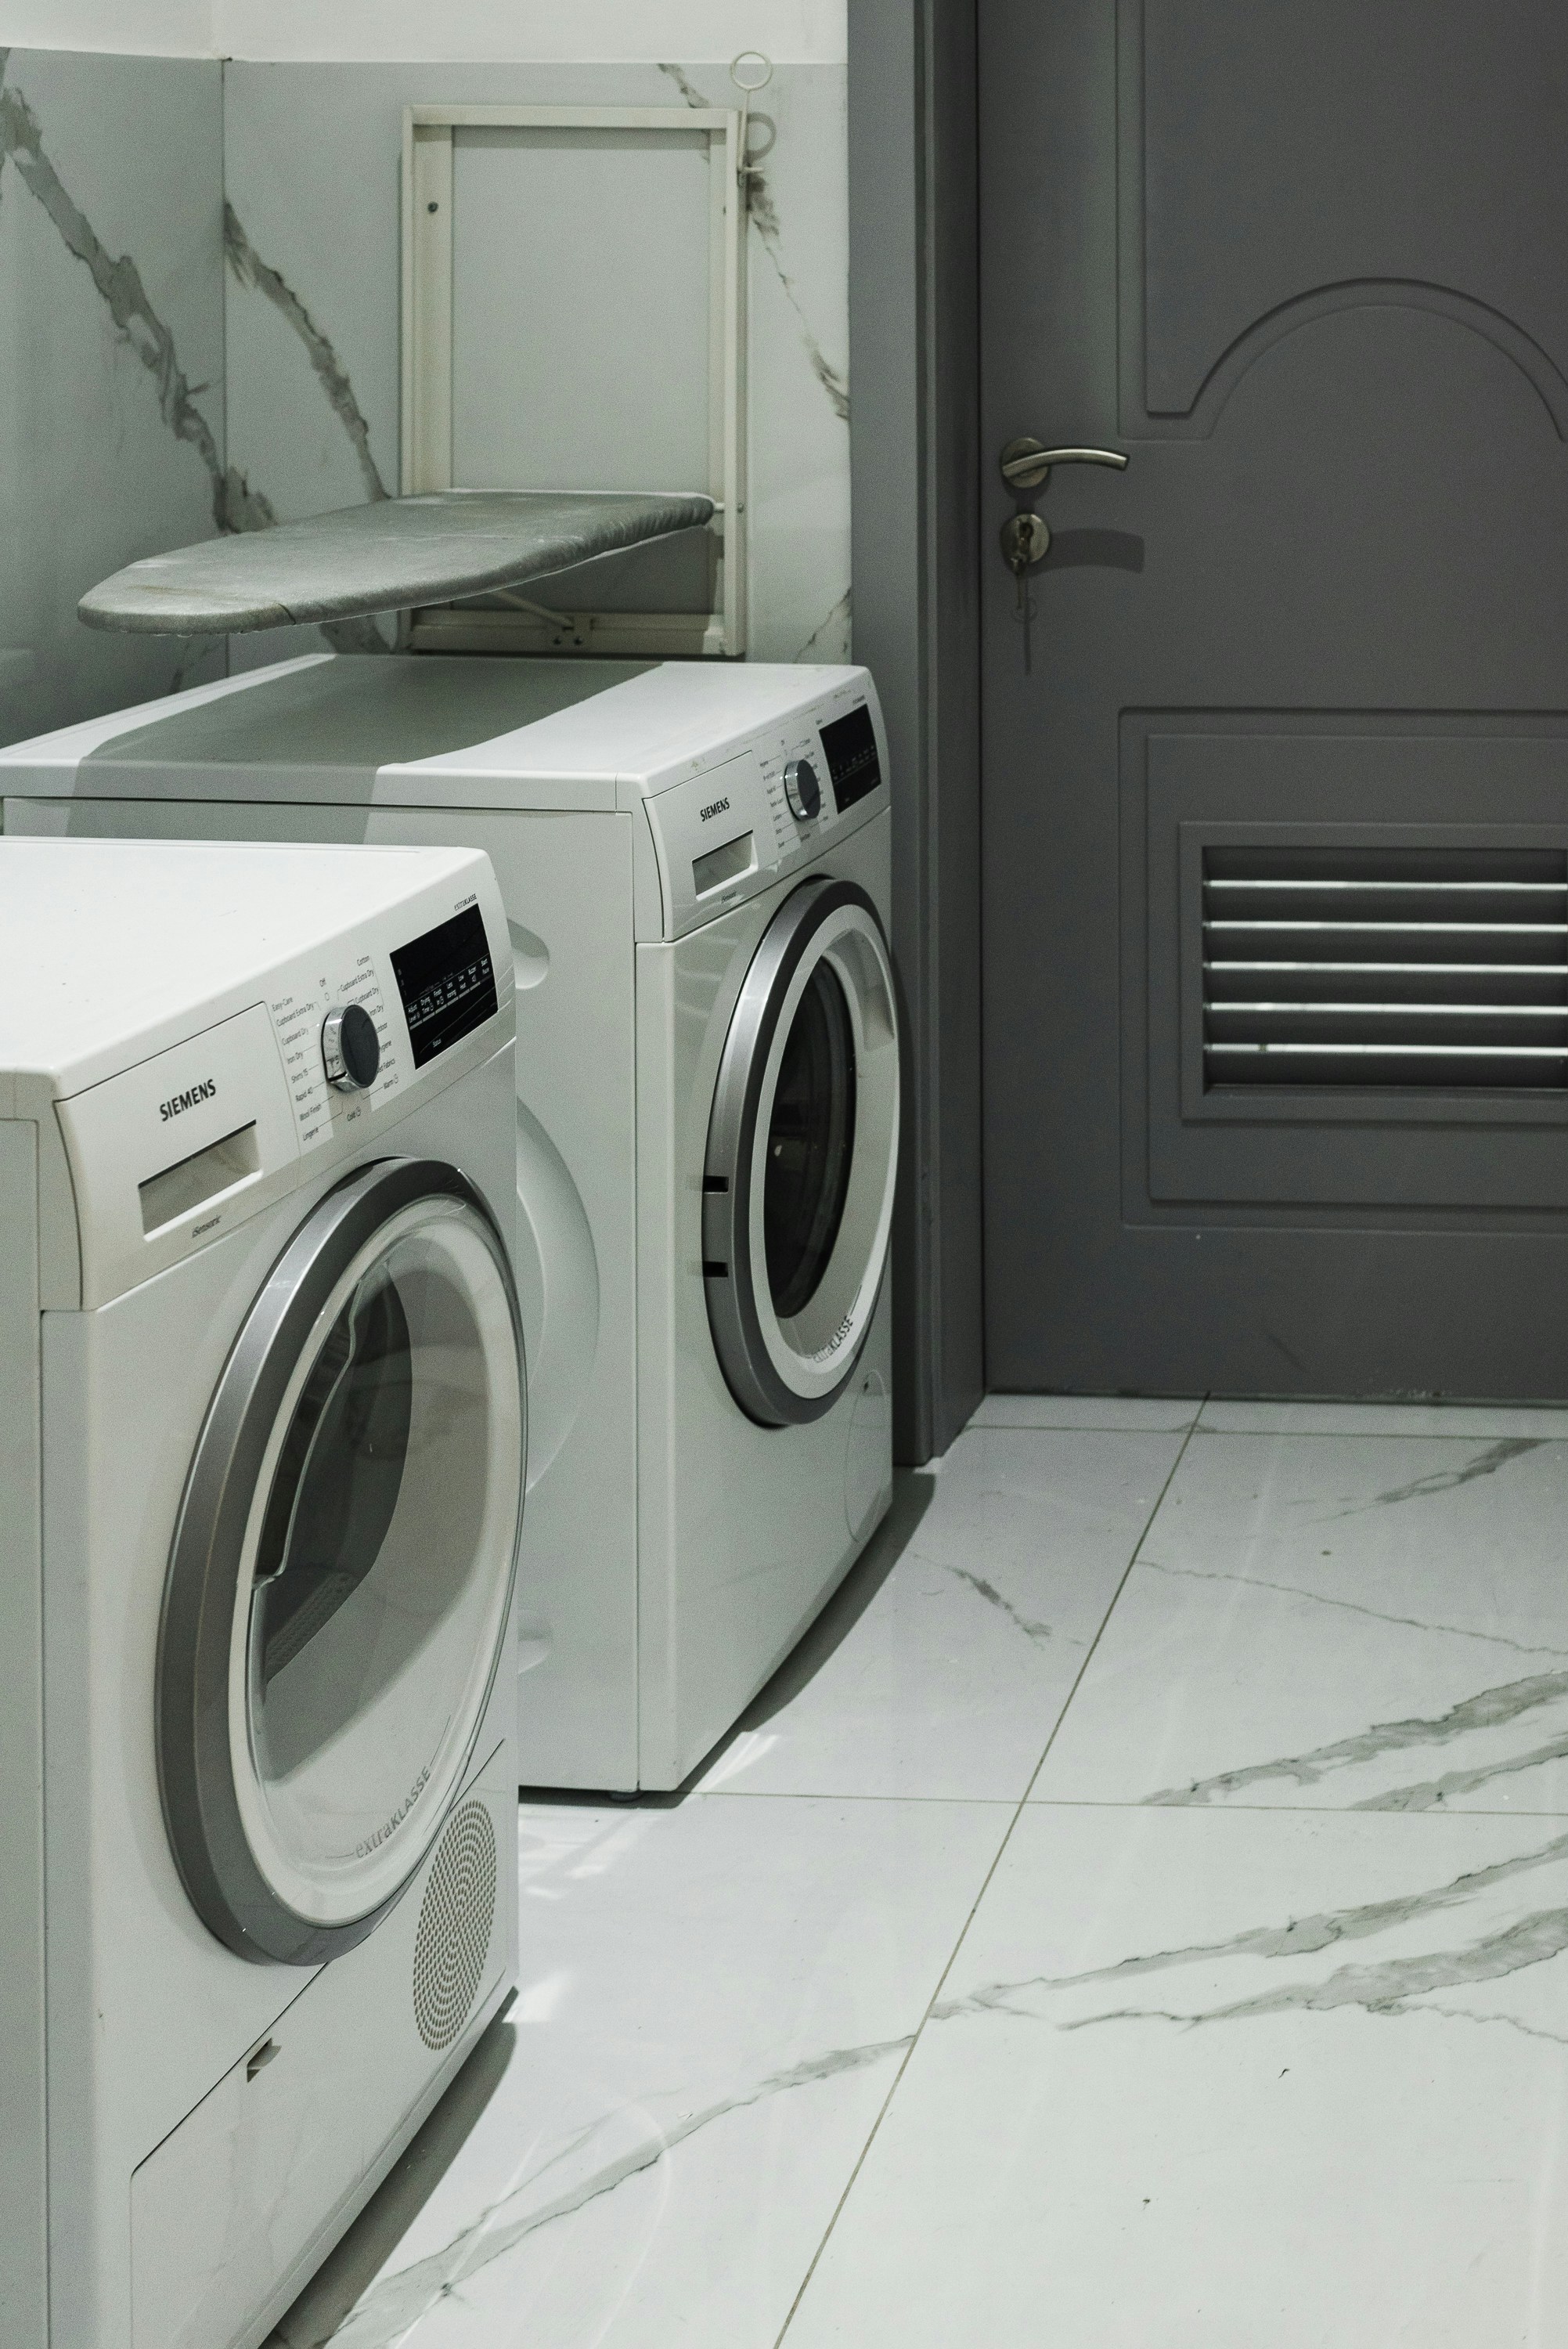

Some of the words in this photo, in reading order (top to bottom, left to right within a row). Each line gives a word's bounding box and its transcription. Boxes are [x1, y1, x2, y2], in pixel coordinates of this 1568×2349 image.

[700, 797, 730, 822] SIEMENS
[159, 1078, 216, 1122] SIEMENS
[355, 1766, 431, 1859] extraKLASSE
